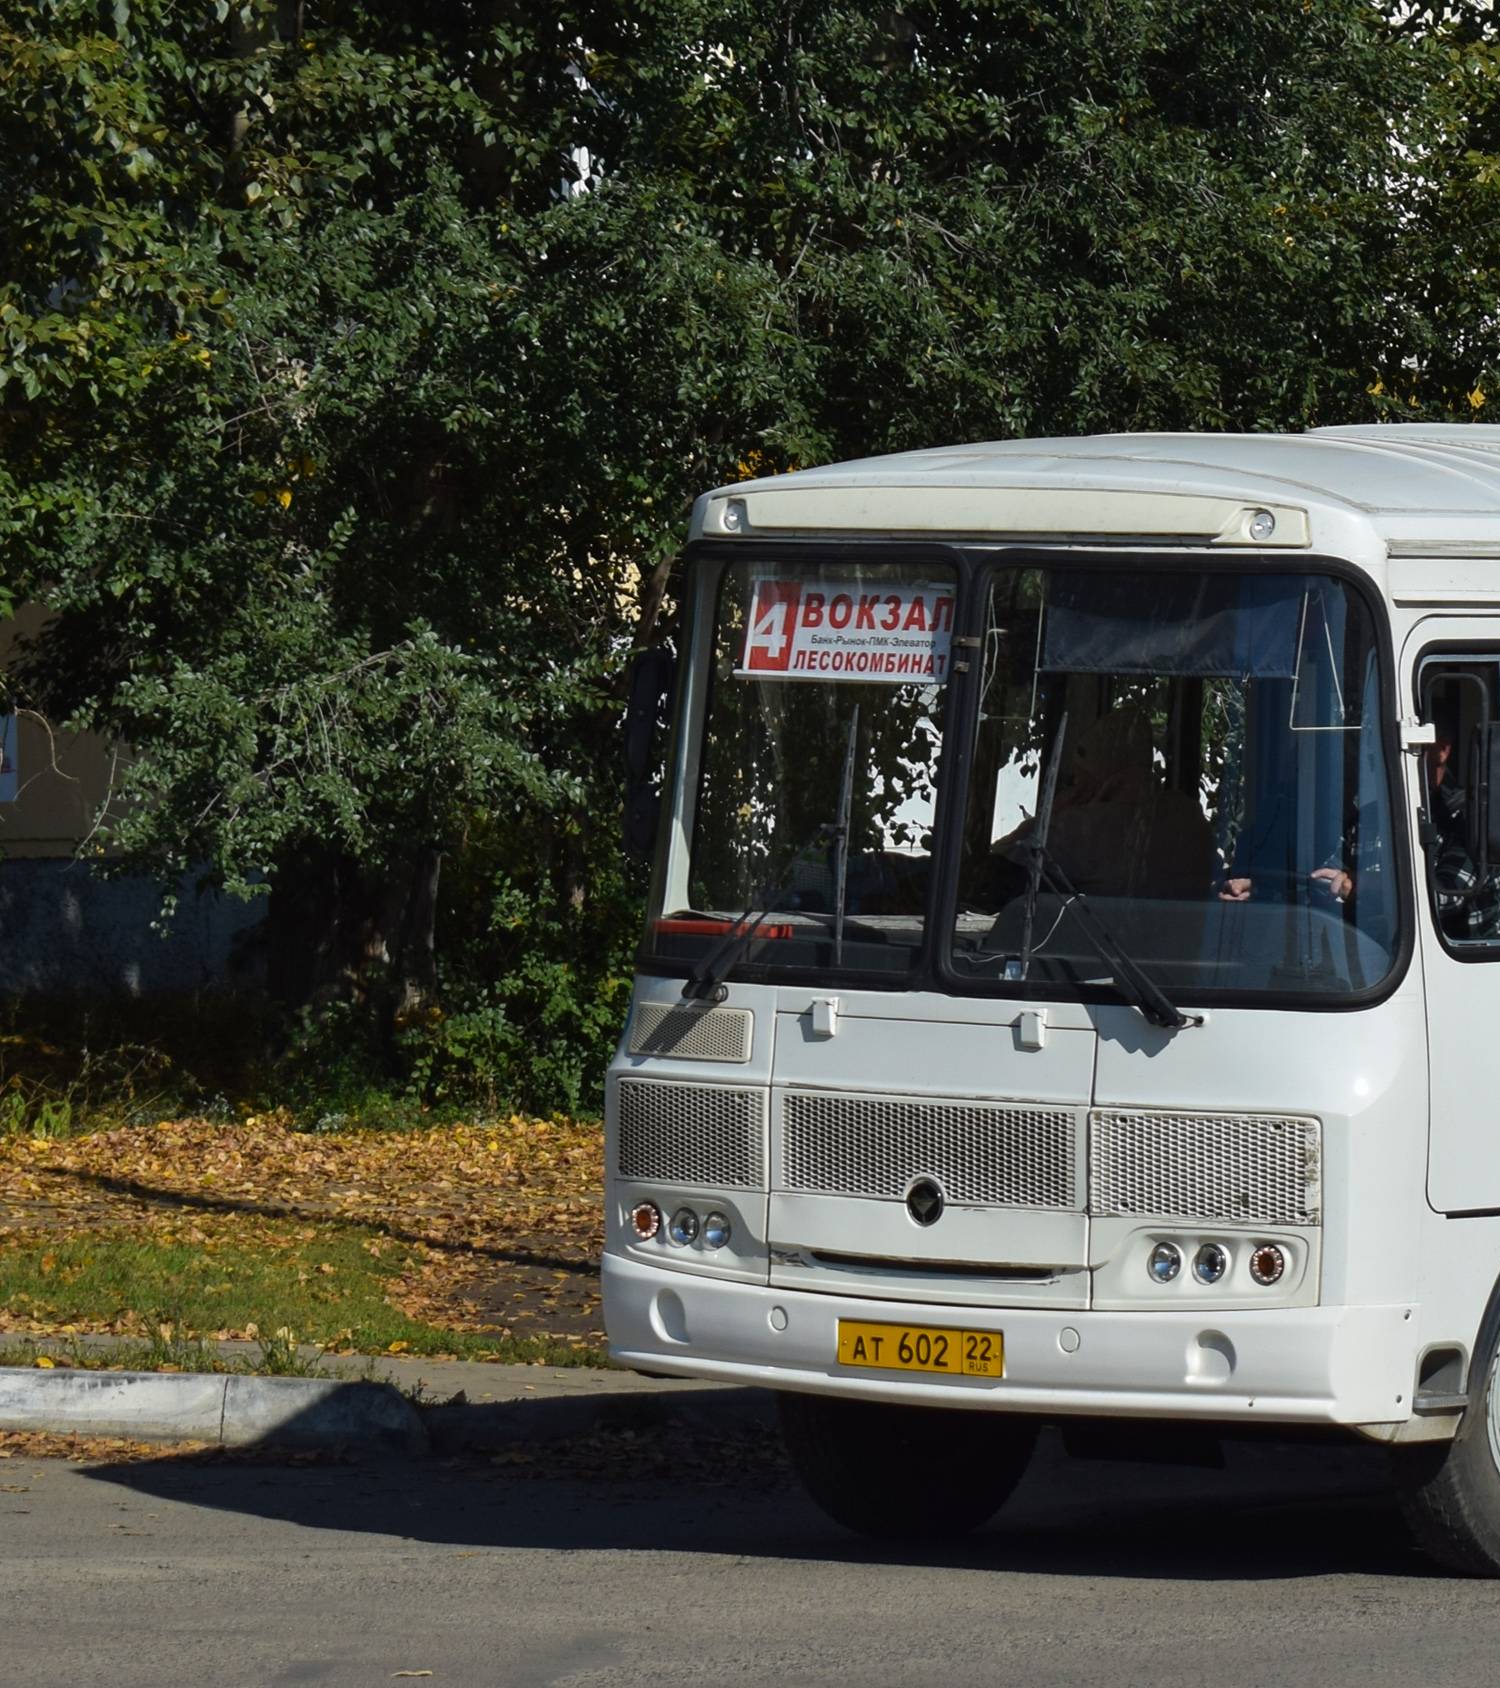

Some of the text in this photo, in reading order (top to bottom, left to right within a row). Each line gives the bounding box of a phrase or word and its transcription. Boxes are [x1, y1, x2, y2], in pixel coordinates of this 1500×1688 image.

[753, 601, 788, 658] 4
[801, 593, 954, 633] ВОКЗАЛ
[793, 650, 947, 675] ЛЕСОКОМБИНАТ
[898, 1332, 949, 1367] 602
[966, 1335, 993, 1361] 22
[968, 1362, 989, 1373] RUS
